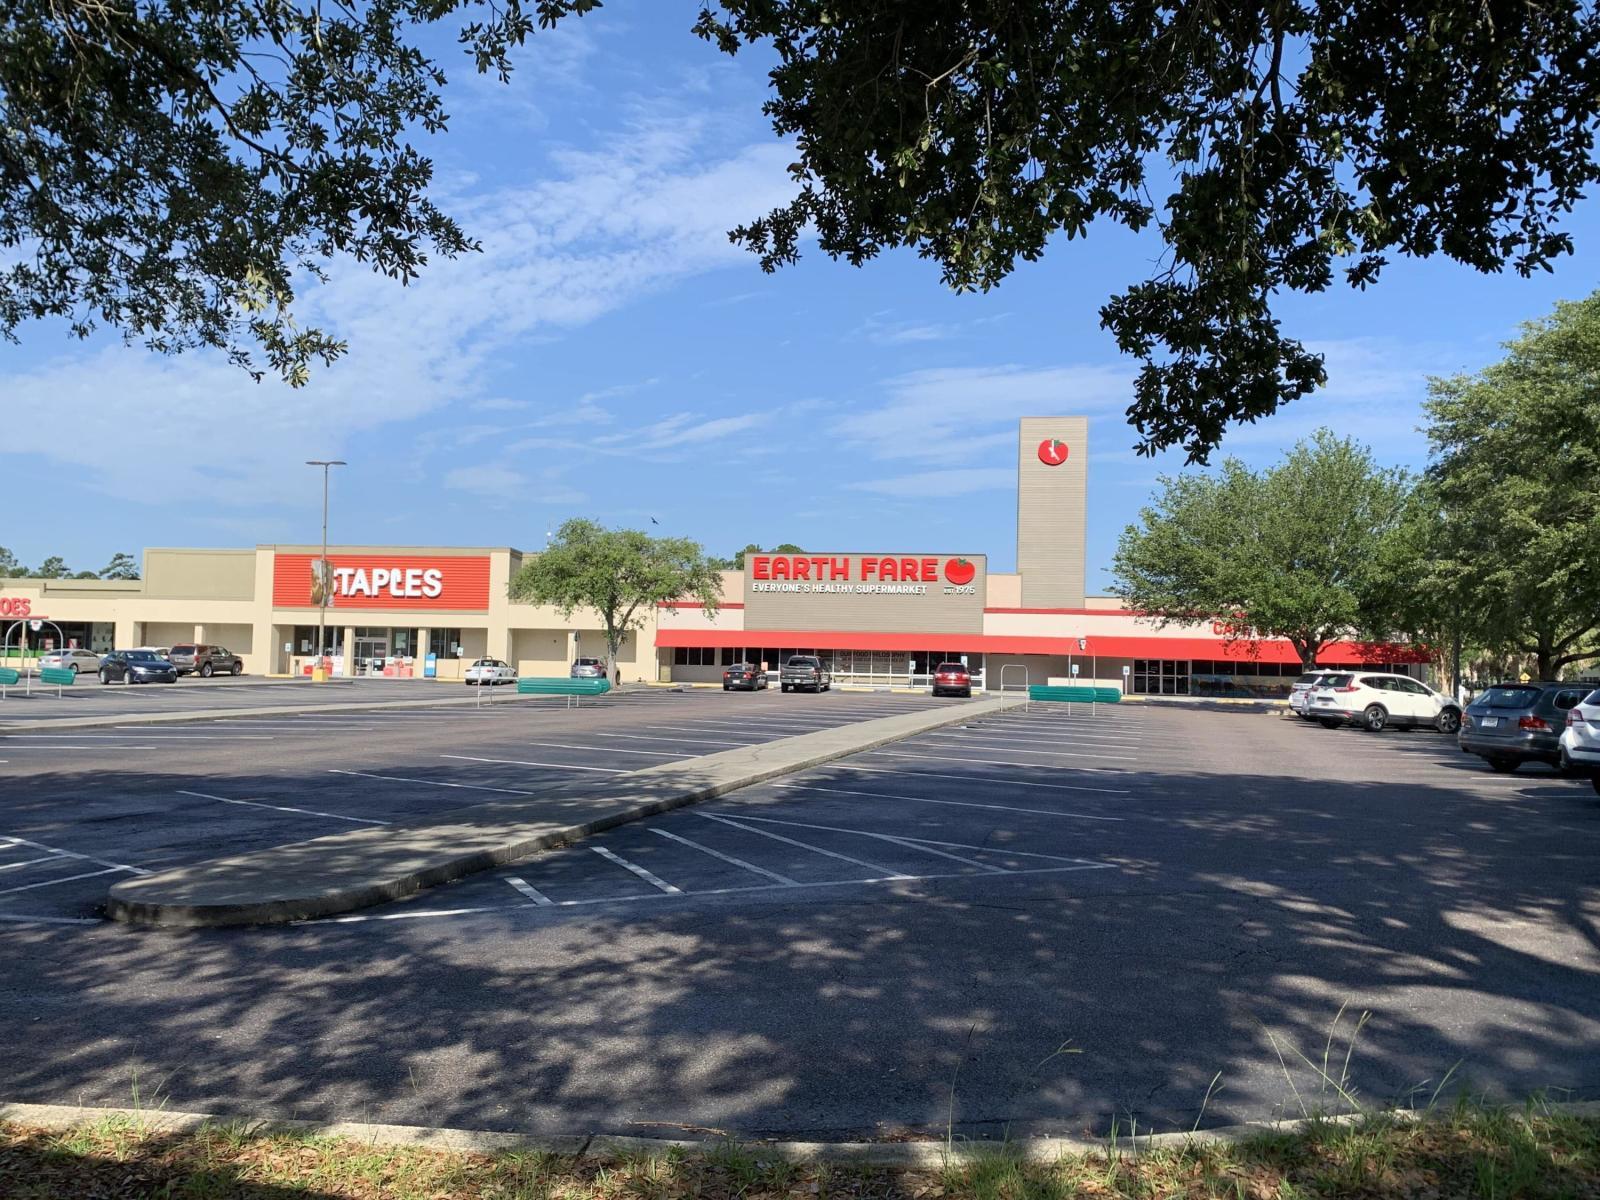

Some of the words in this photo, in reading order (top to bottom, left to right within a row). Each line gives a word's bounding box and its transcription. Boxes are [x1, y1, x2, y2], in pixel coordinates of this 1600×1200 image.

[753, 557, 849, 581] EARTH
[861, 558, 938, 582] FARE
[333, 568, 443, 599] TAPLES
[752, 582, 810, 593] EVERYONE'S
[812, 583, 854, 594] HEALTHY
[856, 585, 927, 596] SUPERMARKET
[956, 586, 976, 595] 1975
